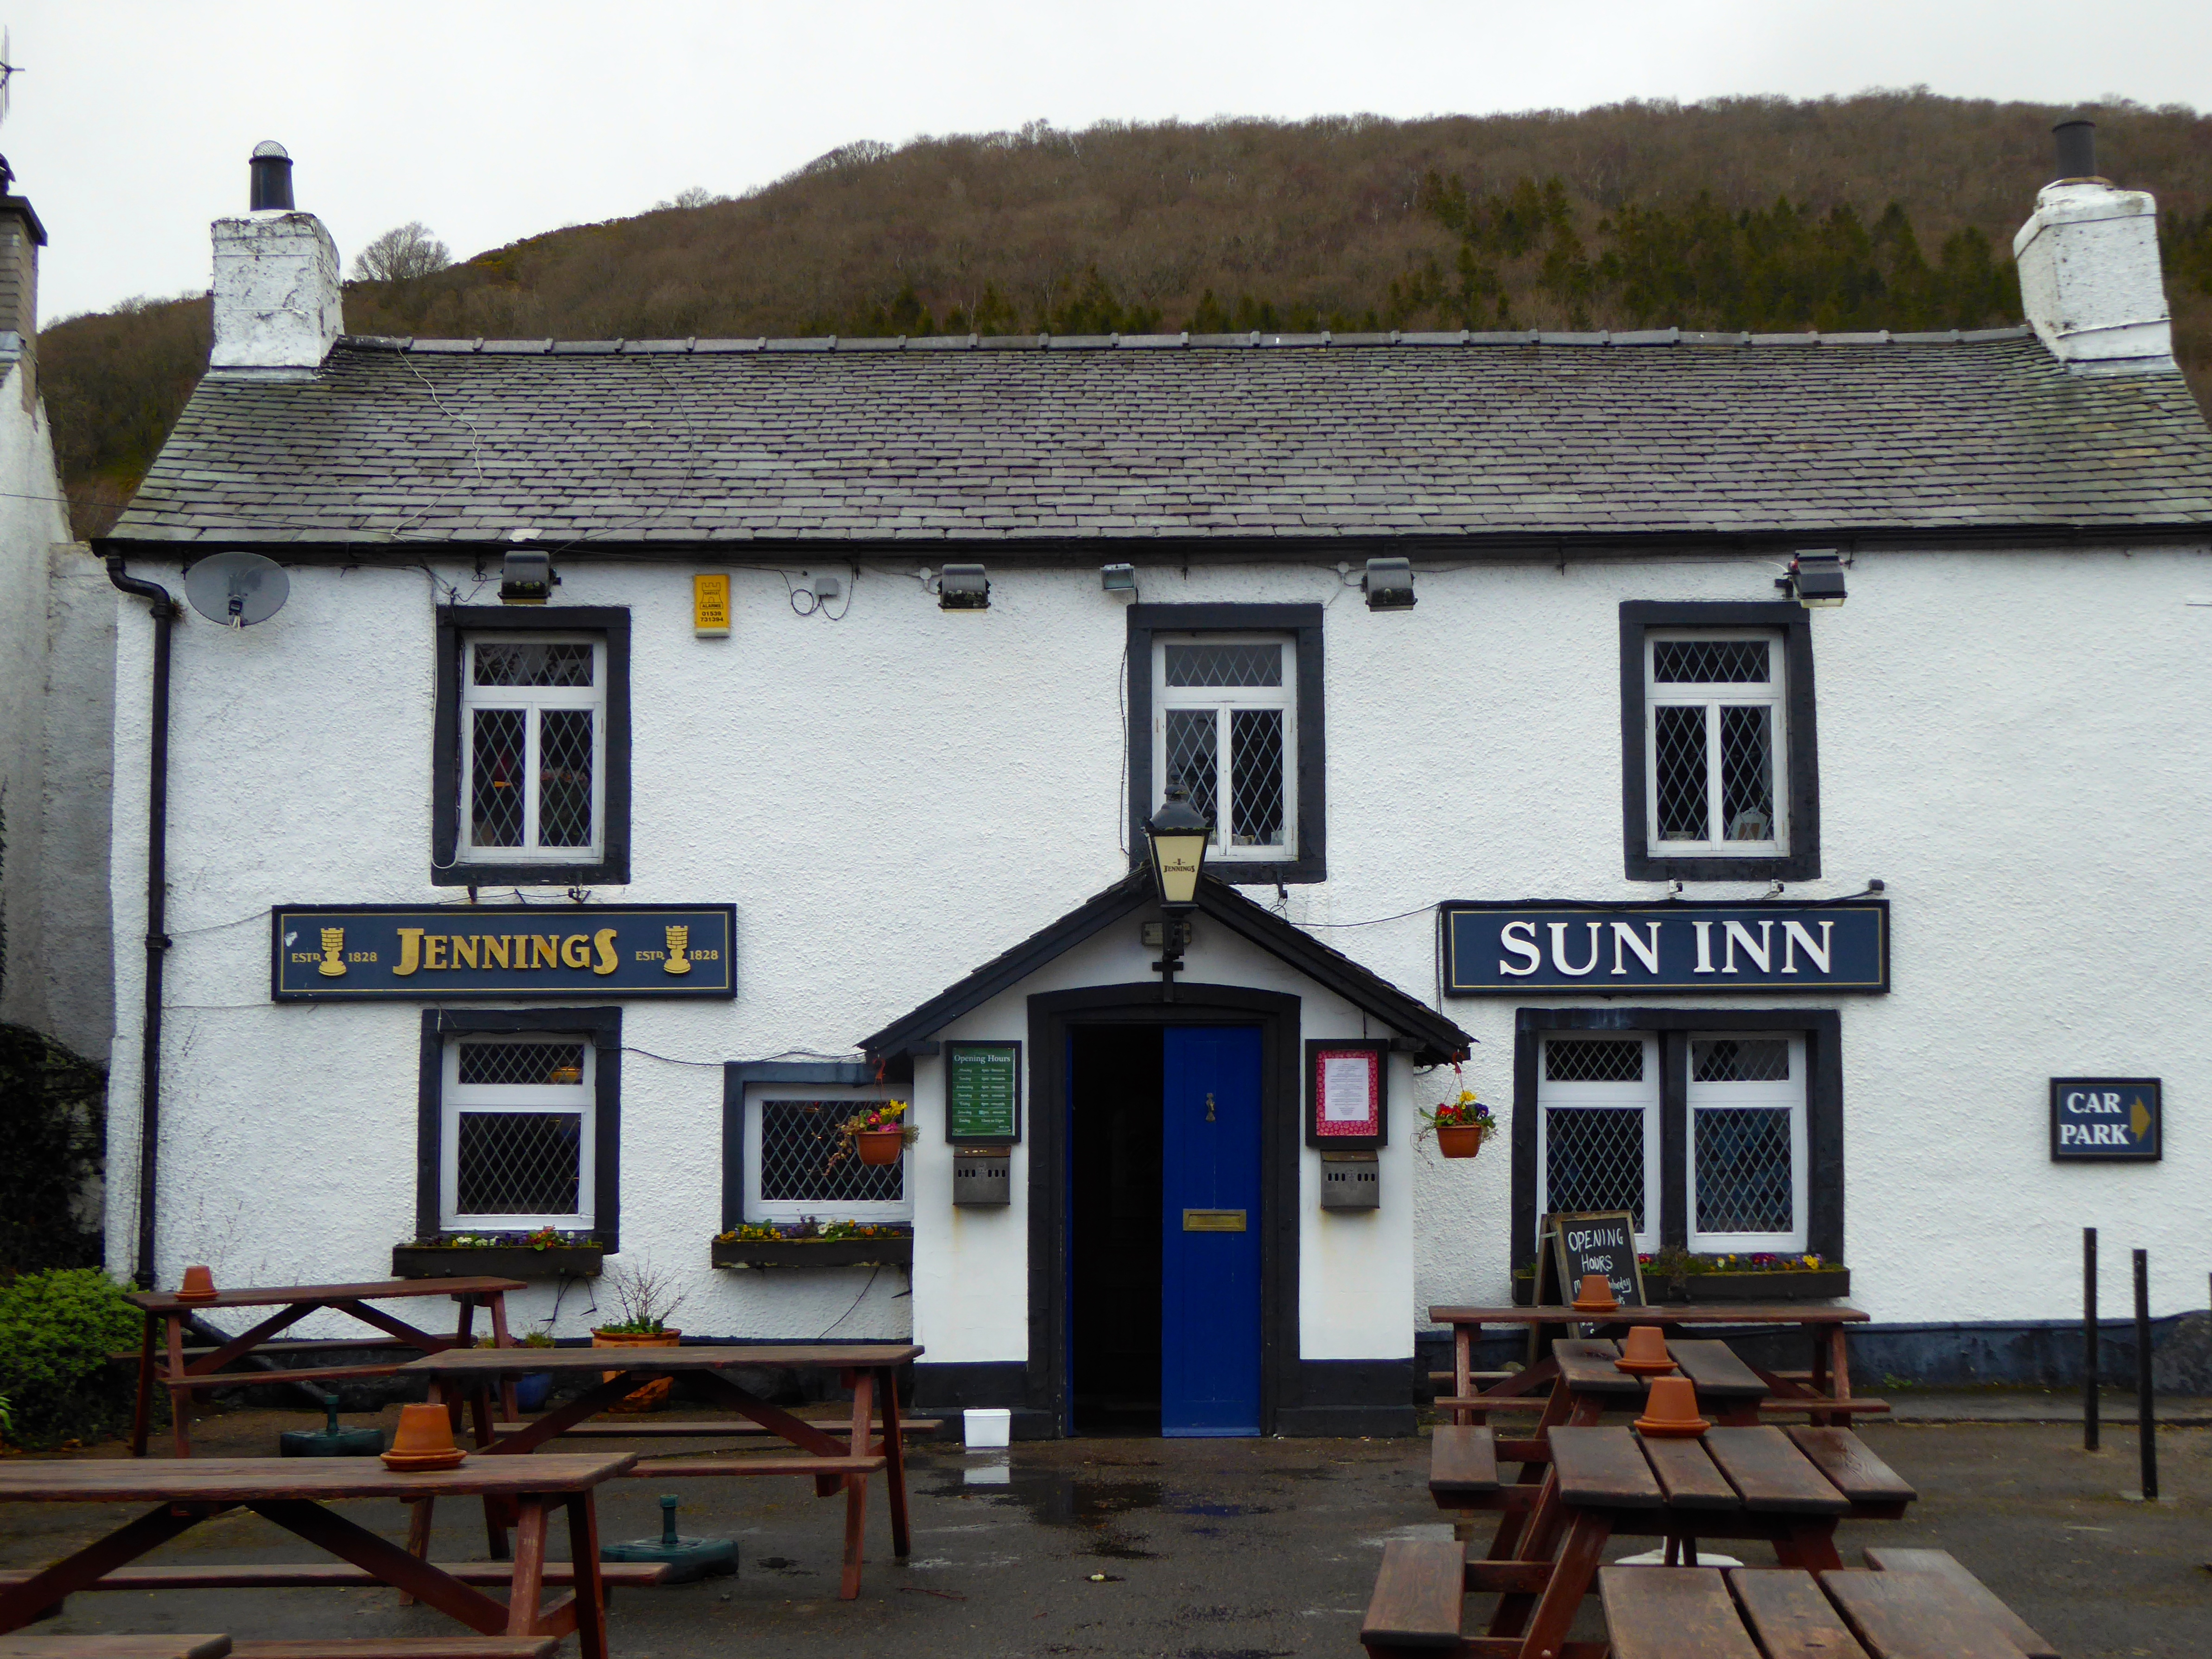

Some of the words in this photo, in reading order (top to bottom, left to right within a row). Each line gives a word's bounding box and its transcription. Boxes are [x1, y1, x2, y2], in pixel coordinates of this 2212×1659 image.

[348, 952, 377, 962] 1828
[393, 928, 618, 975] JENNINGS
[690, 950, 718, 960] 1828
[1500, 922, 1661, 975] SUN
[1692, 921, 1834, 973] INN
[954, 1055, 985, 1064] Opening
[2067, 1092, 2122, 1113] CAR
[2060, 1124, 2130, 1145] PARK
[1568, 1228, 1623, 1252] OPENING
